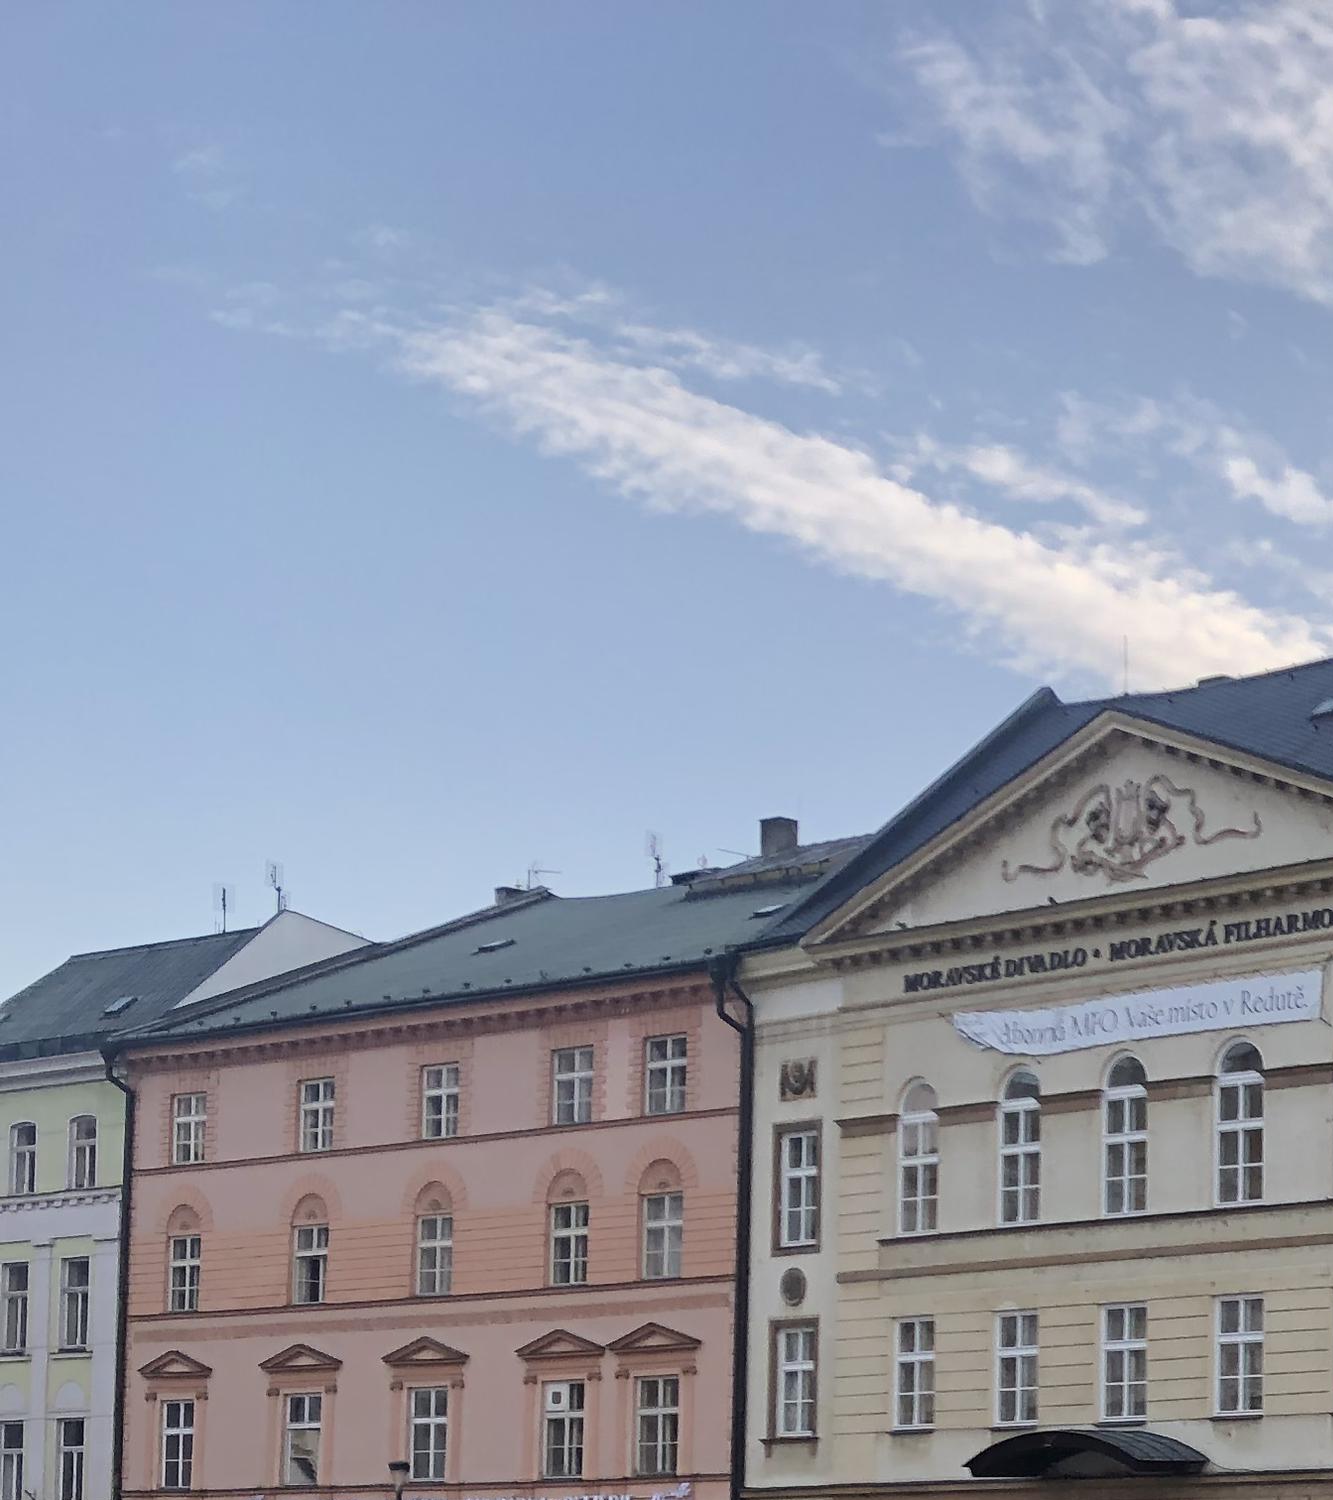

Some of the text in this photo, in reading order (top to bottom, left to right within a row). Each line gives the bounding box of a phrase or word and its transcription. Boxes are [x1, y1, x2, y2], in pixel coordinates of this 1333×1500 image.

[903, 955, 1002, 993] MORAVSKÉ
[1004, 947, 1088, 978] DIVADLO
[1109, 920, 1218, 962] MORAVSKÁ
[1168, 998, 1218, 1024] místo
[1223, 999, 1235, 1016] v
